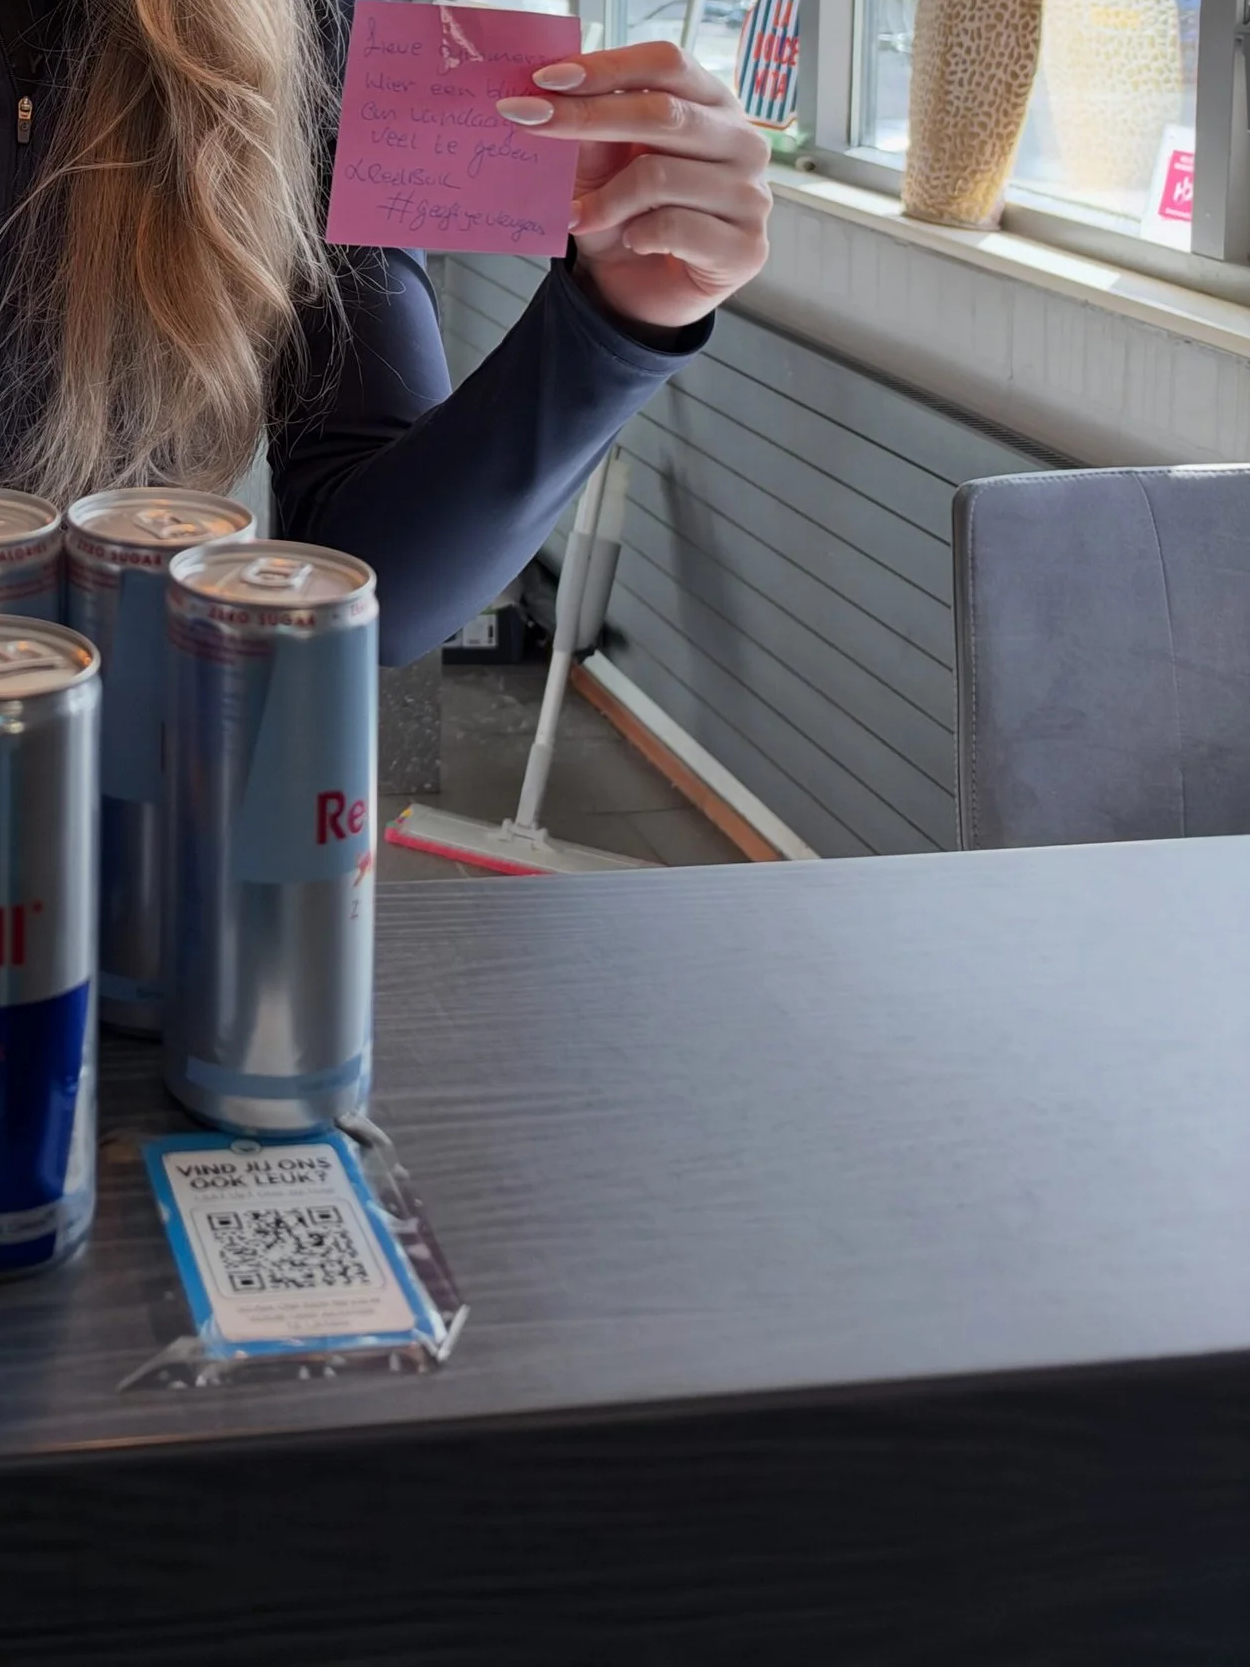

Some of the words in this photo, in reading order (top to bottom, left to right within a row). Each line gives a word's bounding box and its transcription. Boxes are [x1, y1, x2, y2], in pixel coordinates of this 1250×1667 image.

[753, 30, 799, 66] DOLCE
[430, 84, 476, 99] een
[435, 135, 458, 155] te
[110, 551, 162, 566] SUGAR
[257, 612, 316, 627] SUGAR
[316, 790, 367, 846] Re
[176, 1162, 237, 1178] VIND
[278, 1156, 333, 1171] ONS
[189, 1174, 247, 1190] OOK
[254, 1170, 328, 1185] LEUK?
